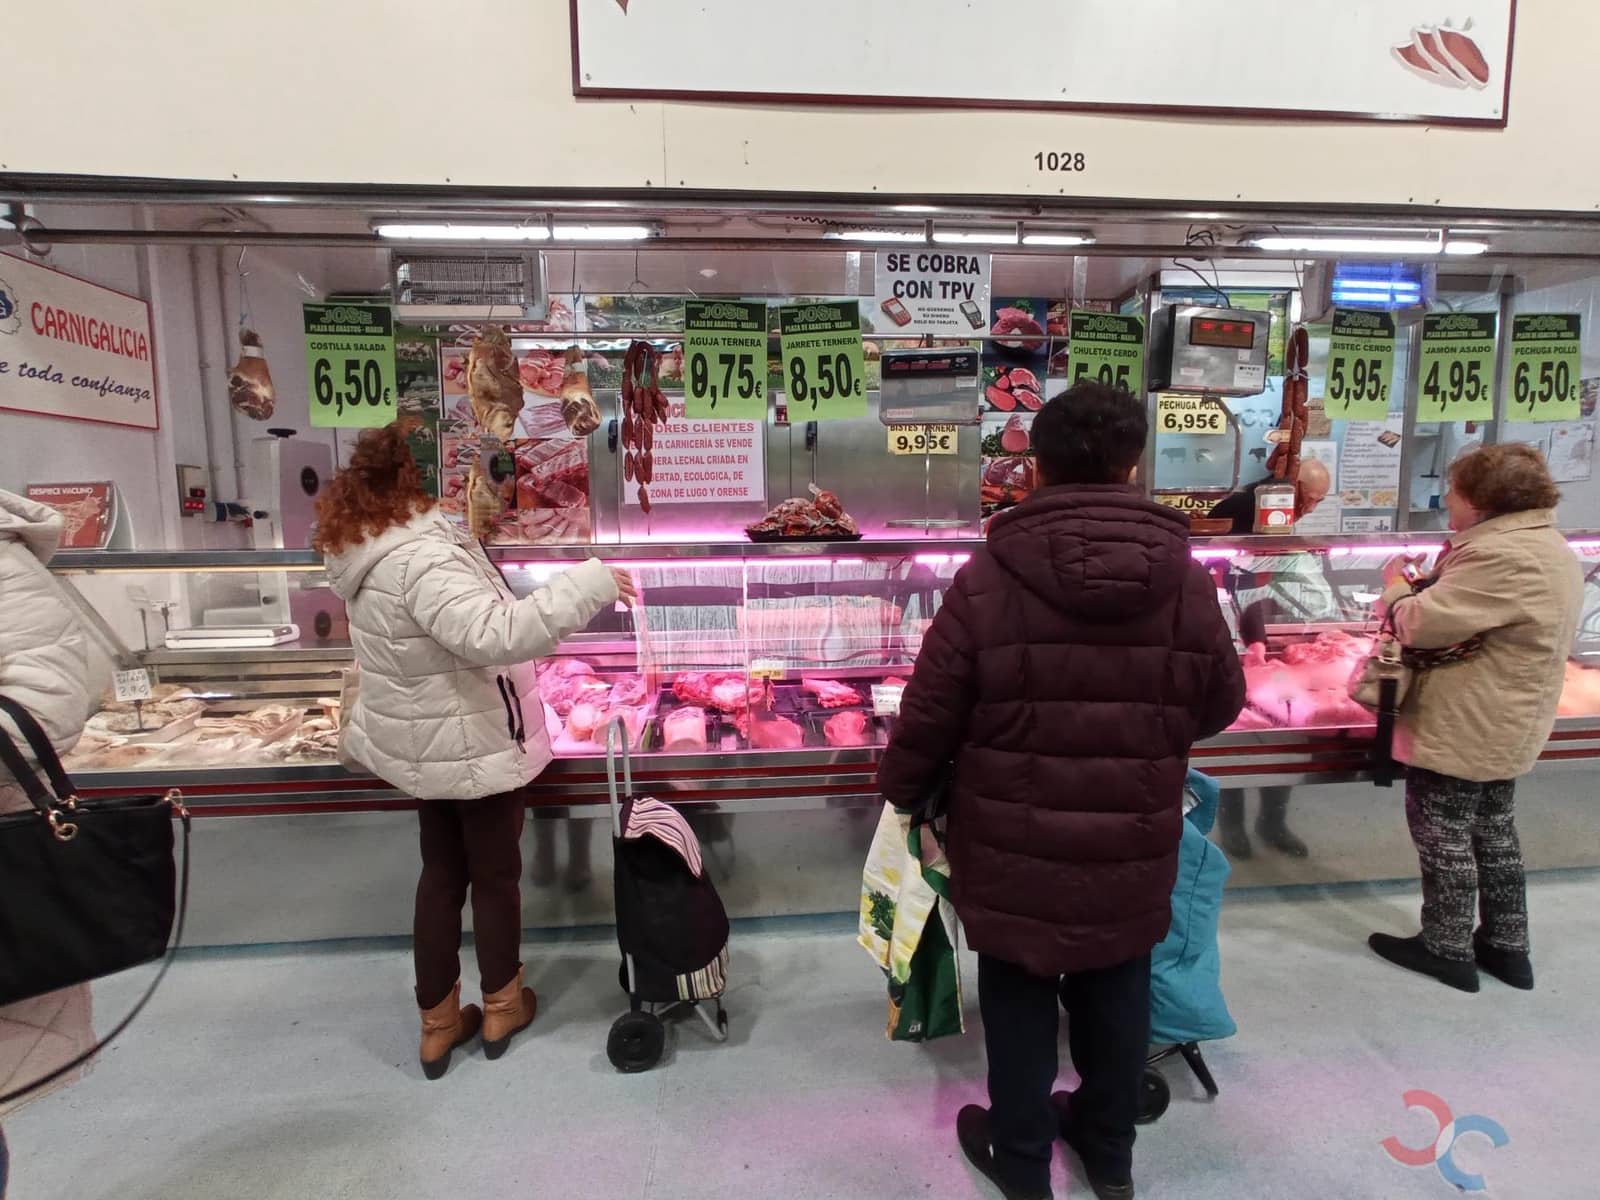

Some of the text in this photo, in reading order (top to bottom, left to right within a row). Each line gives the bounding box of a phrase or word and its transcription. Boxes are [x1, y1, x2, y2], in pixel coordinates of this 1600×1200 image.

[1034, 151, 1085, 171] 1028
[887, 253, 981, 275] SE COBRA
[893, 280, 975, 300] CON TPV
[31, 302, 148, 361] CARNIGALICIA
[310, 342, 386, 351] COSTILLA SALADA
[690, 337, 762, 347] AGUJA TERNERA
[786, 337, 858, 349] JARRETE TERNERA
[1333, 343, 1361, 351] BISTEC
[1073, 347, 1138, 357] CHULETAS CERDO
[1515, 346, 1577, 355] PECHUGA POLLO
[18, 363, 64, 384] toda
[71, 375, 151, 403] confianza
[314, 358, 392, 416] 6,50€
[790, 353, 861, 411] 8,50€
[1330, 357, 1387, 410] 5,95€
[1424, 360, 1488, 412] 4,95€
[1514, 360, 1576, 413] 6,50€
[1159, 400, 1221, 410] PECHUGA POLL
[655, 422, 754, 432] ORES CLIENTES
[1164, 413, 1219, 431] 6,95€
[654, 438, 753, 449] TA CARNICERÍA SE VENDE
[896, 435, 950, 452] 9,95€
[674, 456, 705, 464] LECHAL
[706, 455, 735, 464] CRIADA
[737, 455, 748, 464] EN
[733, 471, 744, 480] DE
[650, 487, 749, 498] ZONA DE LUGO Y ORENSE
[1174, 496, 1215, 508] JOSE
